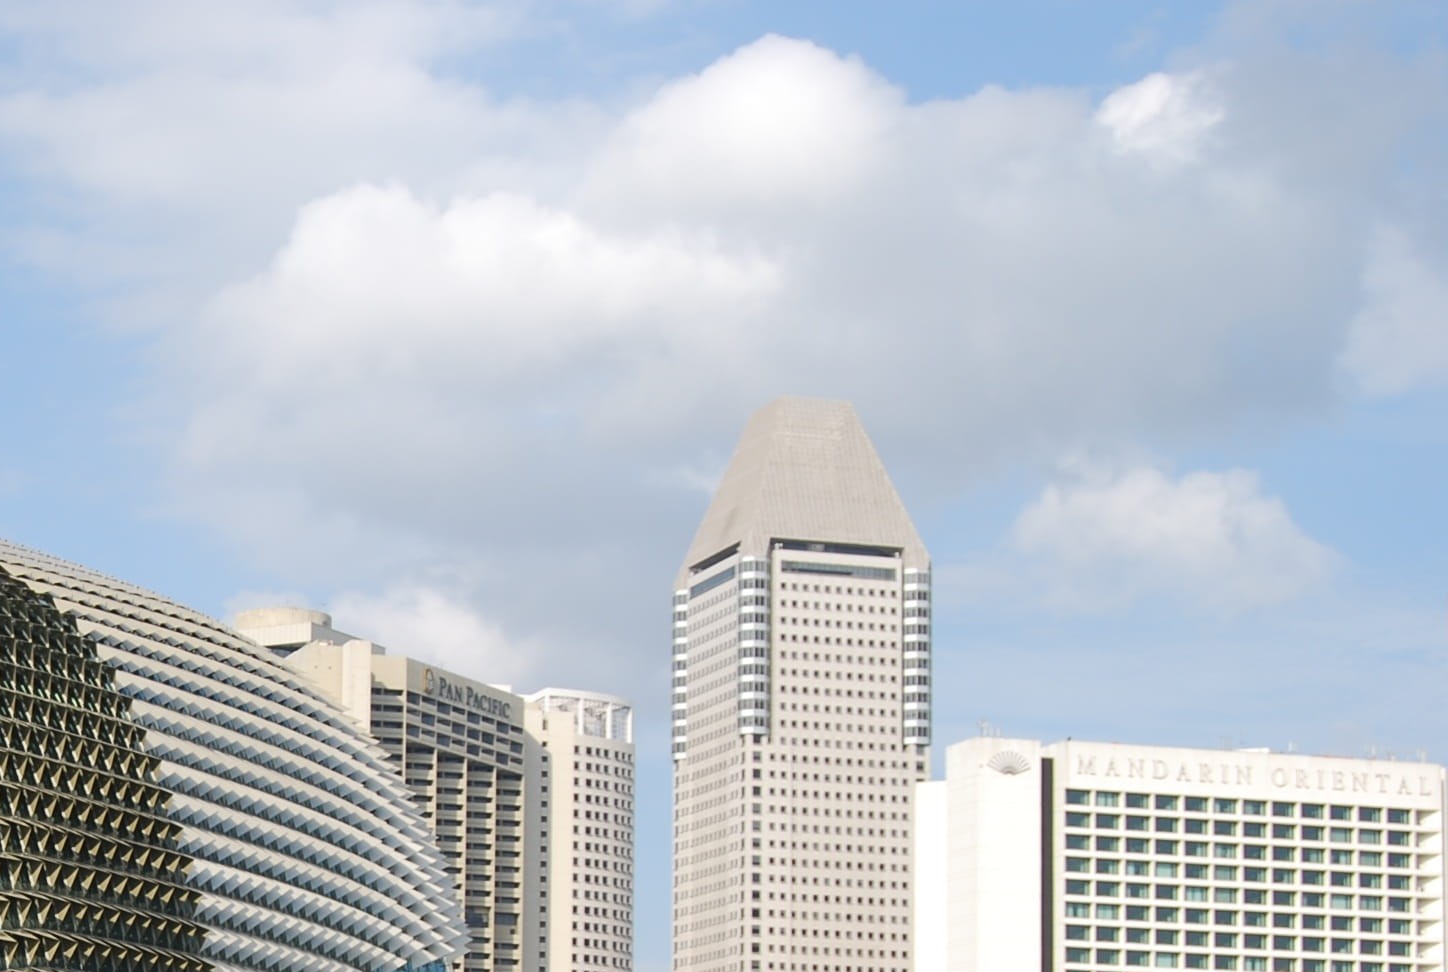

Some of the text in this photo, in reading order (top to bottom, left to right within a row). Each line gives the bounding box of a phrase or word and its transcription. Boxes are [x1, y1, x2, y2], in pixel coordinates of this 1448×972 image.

[438, 677, 512, 719] PAN PACIFIC
[1077, 754, 1432, 796] MANDARIN ORIENTAL
